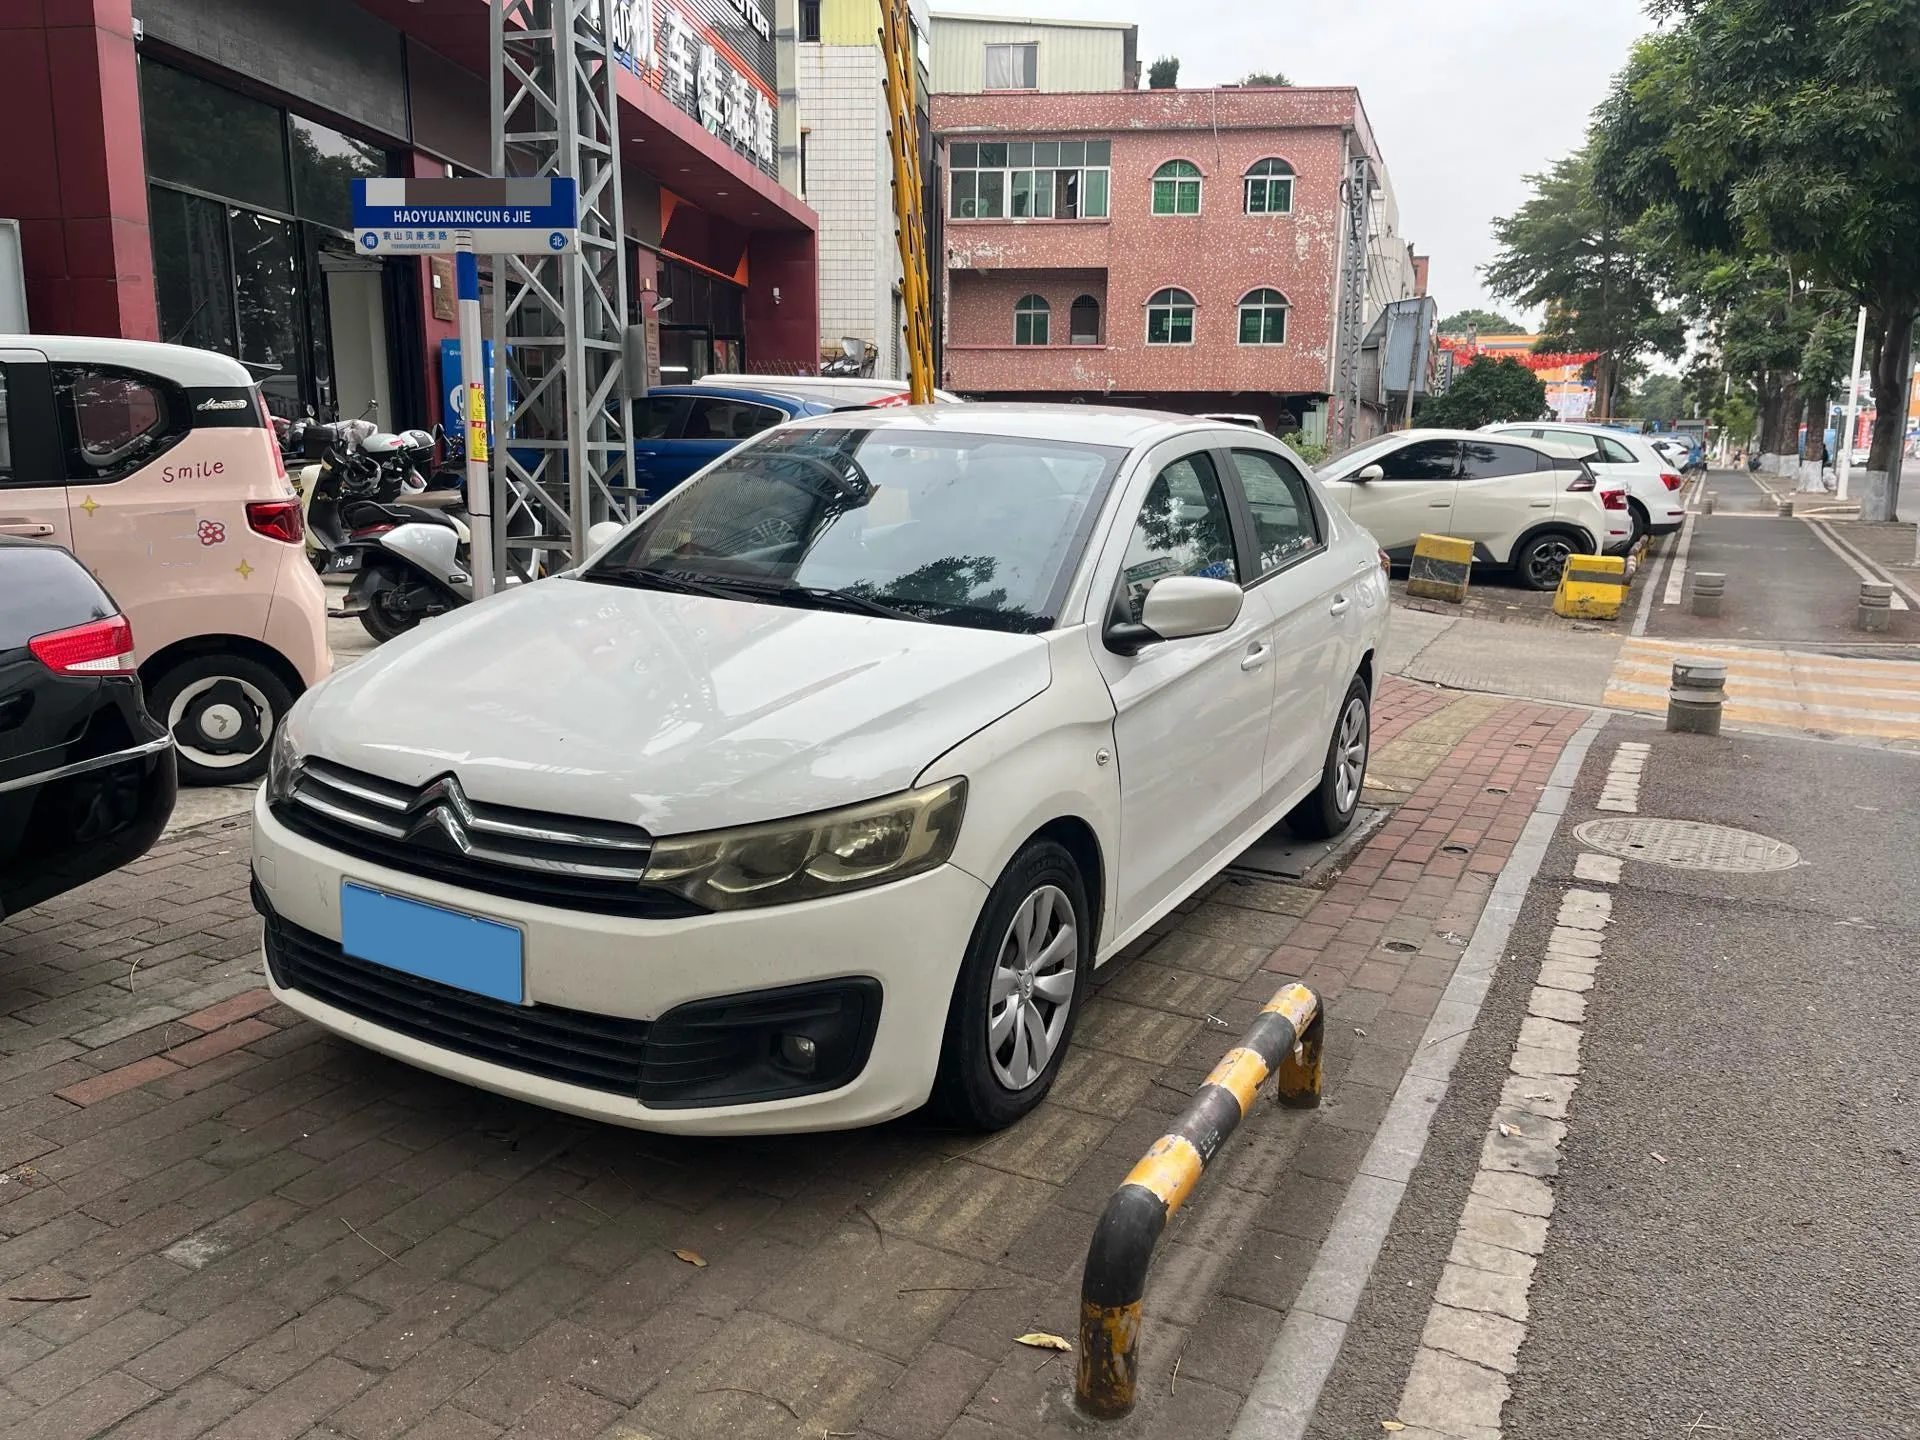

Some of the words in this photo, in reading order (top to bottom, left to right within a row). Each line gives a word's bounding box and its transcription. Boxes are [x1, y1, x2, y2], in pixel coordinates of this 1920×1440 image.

[394, 210, 501, 223] HAOYUANXINCUN
[503, 210, 511, 223] 6
[512, 210, 532, 223] JIE
[365, 235, 376, 247] 南
[552, 236, 563, 247] 北
